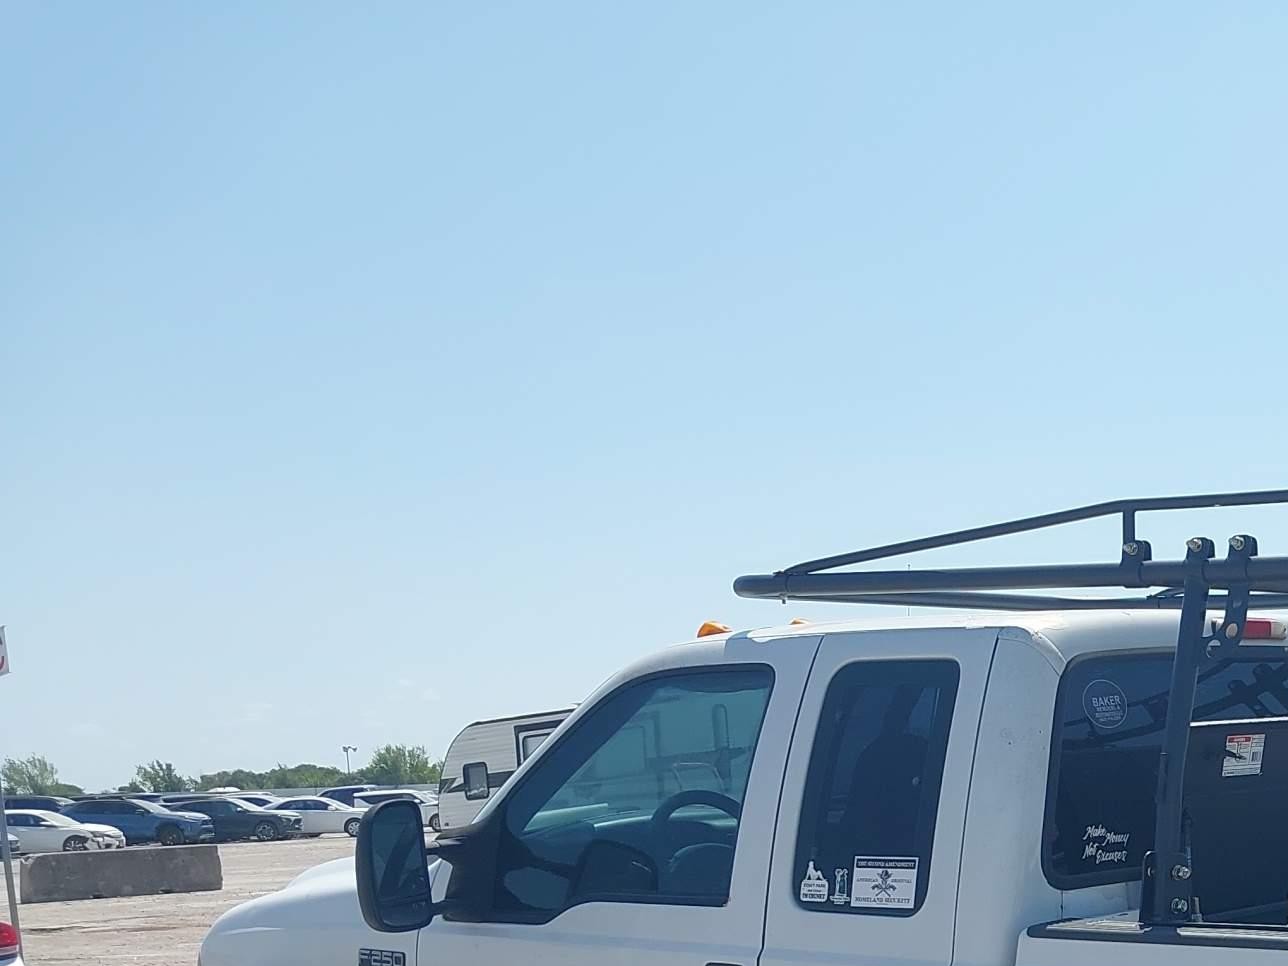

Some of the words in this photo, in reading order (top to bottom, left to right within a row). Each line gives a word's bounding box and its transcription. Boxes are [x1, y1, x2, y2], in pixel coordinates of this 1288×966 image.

[1091, 695, 1122, 708] BAKER
[1082, 824, 1107, 841] Make
[1101, 832, 1130, 848] Money
[1082, 842, 1099, 859] Not
[1095, 849, 1128, 864] Excuses
